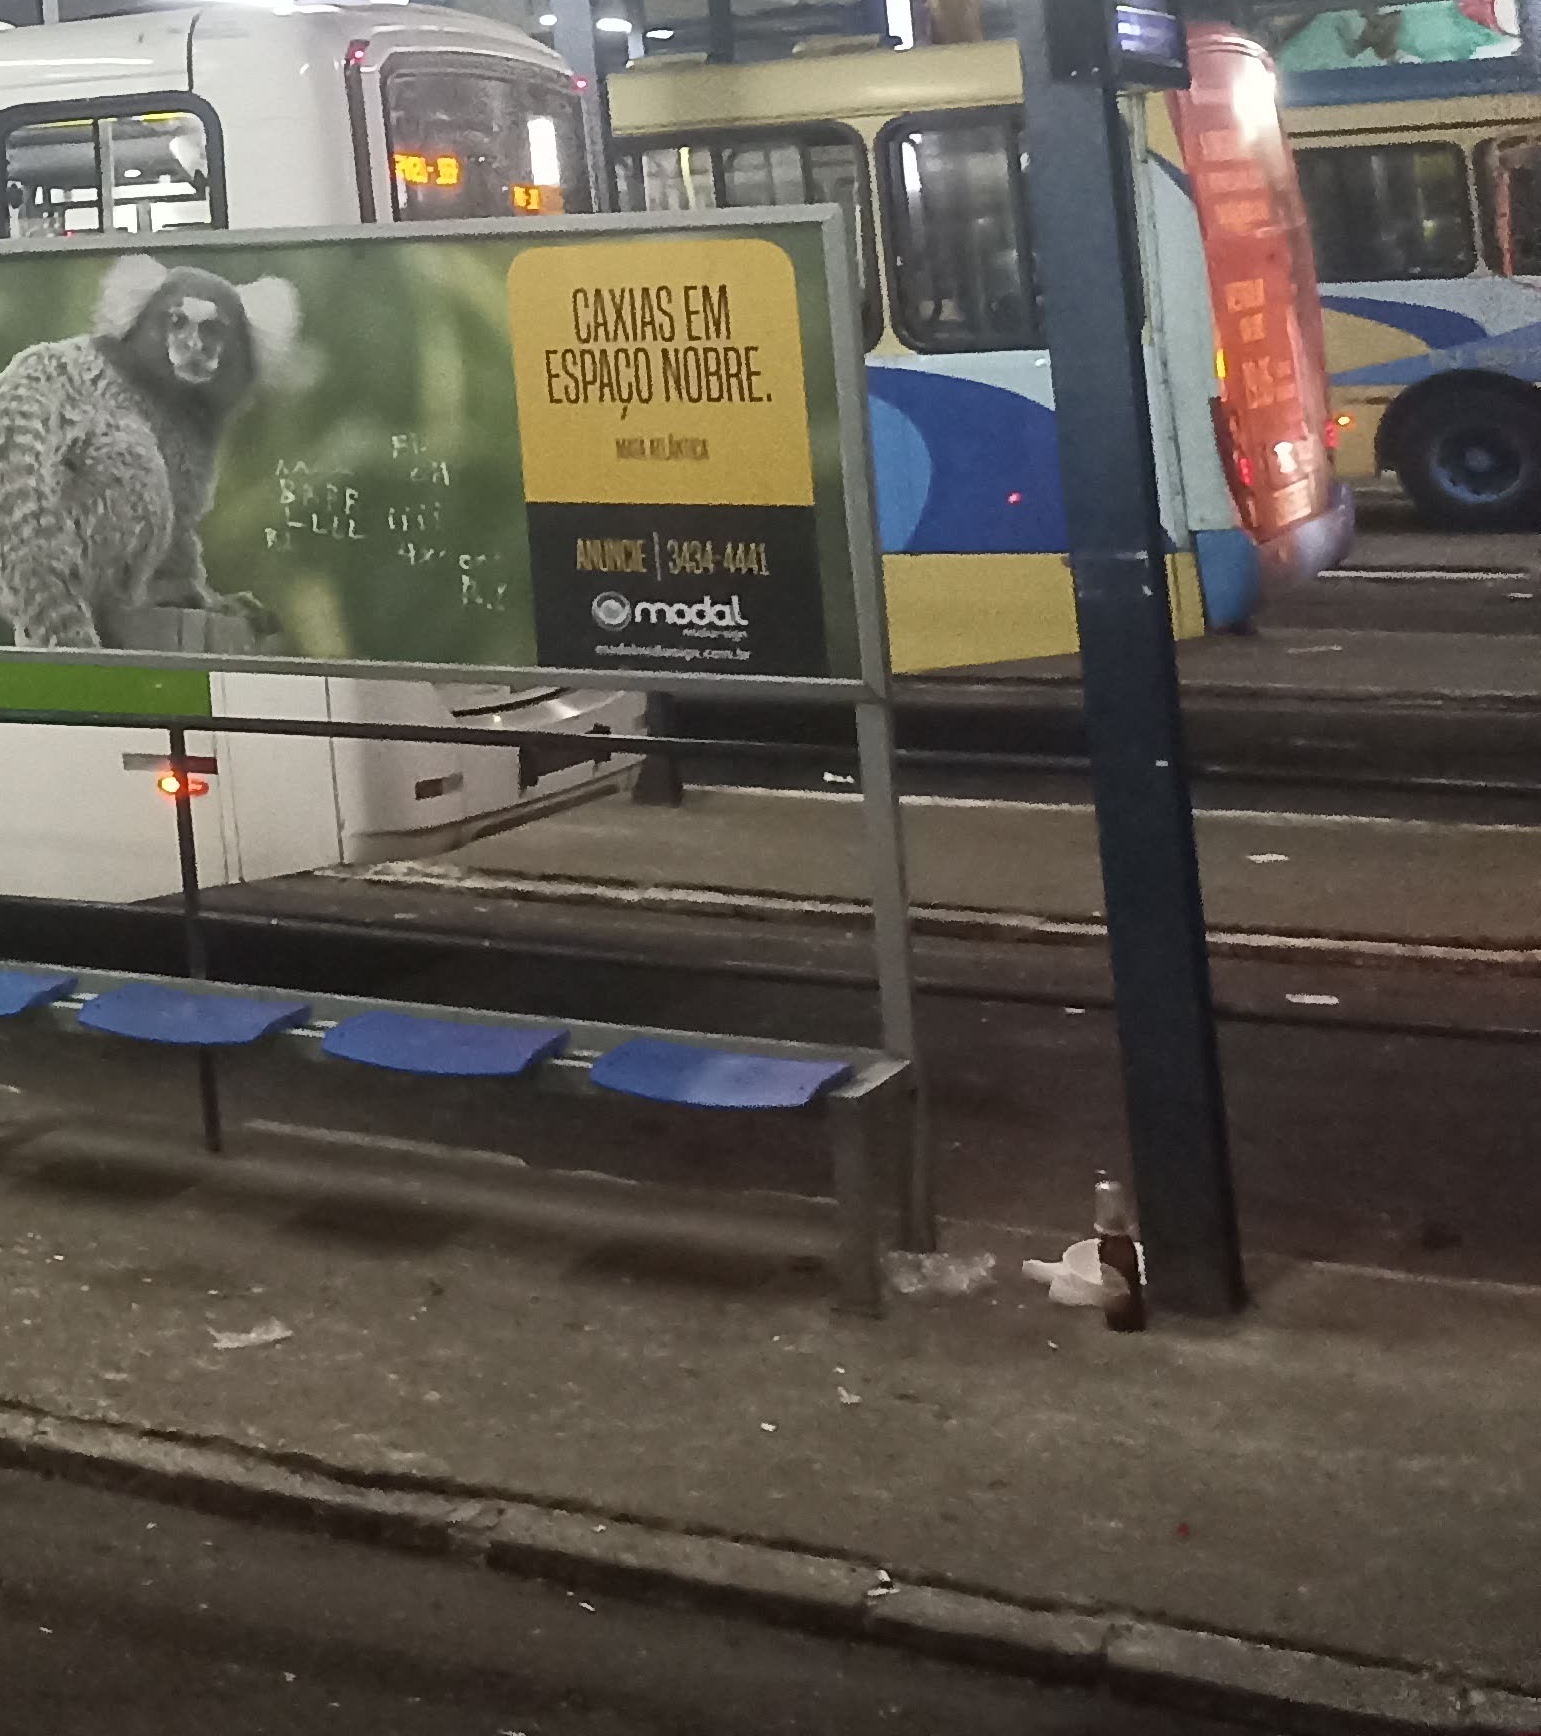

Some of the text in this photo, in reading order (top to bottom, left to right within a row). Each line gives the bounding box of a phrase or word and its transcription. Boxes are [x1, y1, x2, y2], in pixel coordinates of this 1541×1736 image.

[571, 283, 733, 345] CAXIAS EM
[545, 344, 774, 421] ESPAÇO NOBRE.
[576, 537, 771, 577] ANUNCIE 3434-4441
[633, 594, 750, 627] modal
